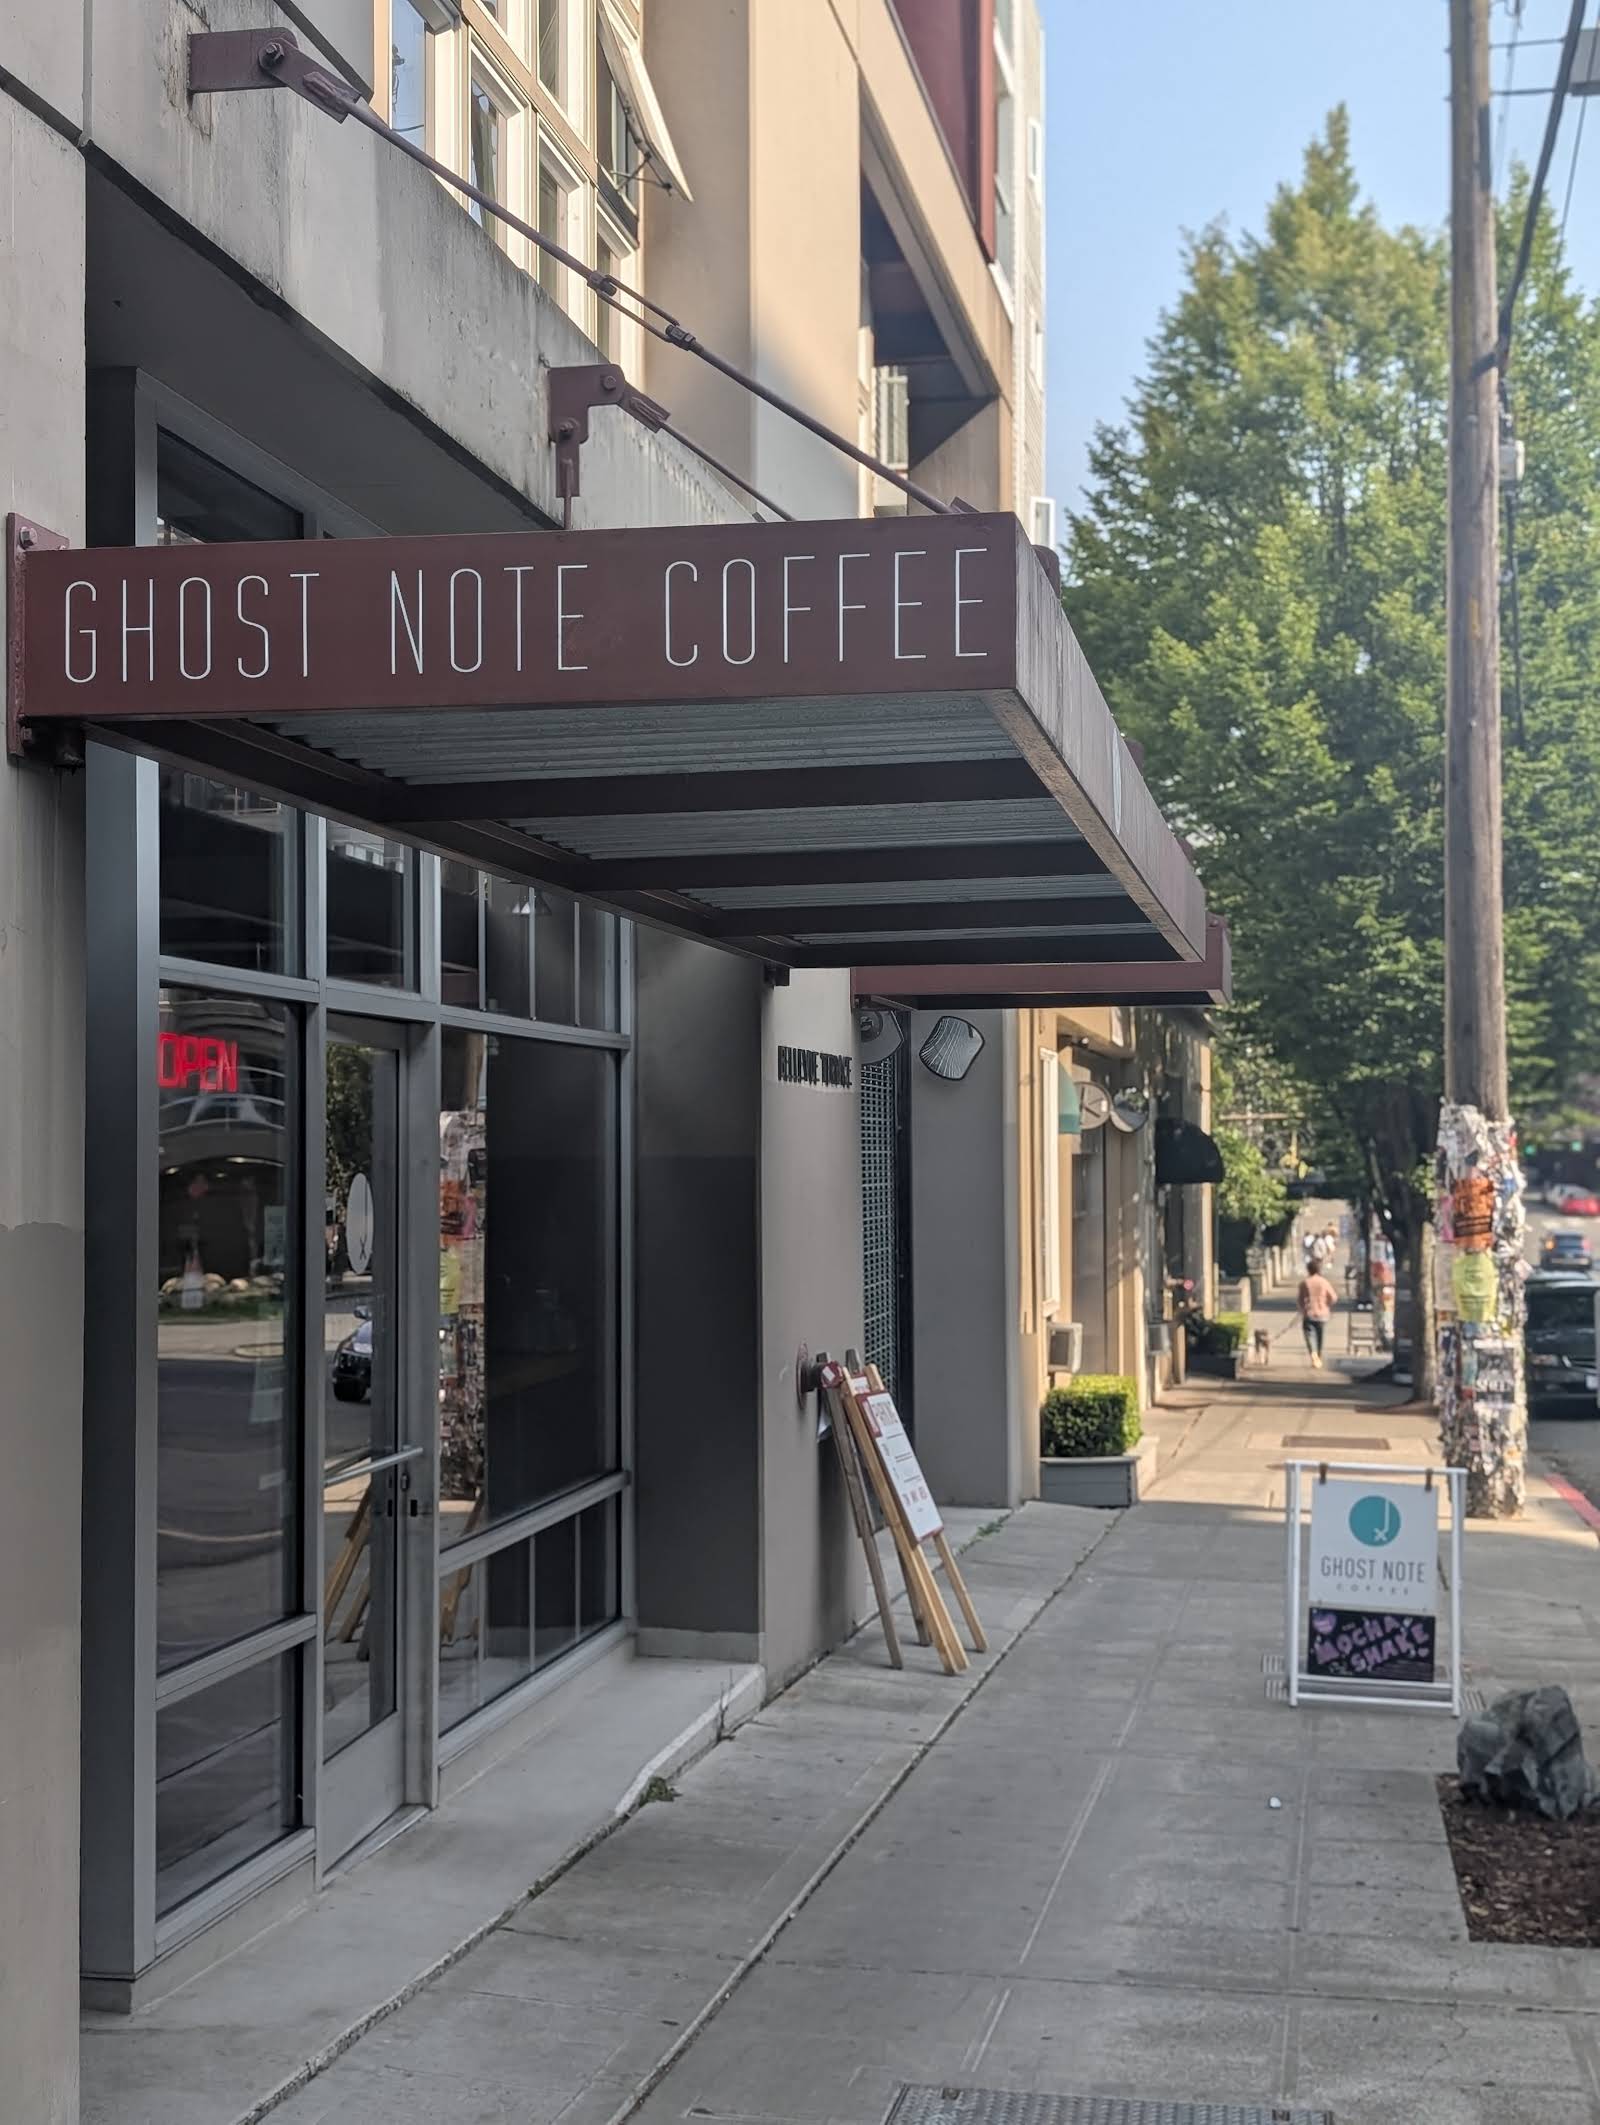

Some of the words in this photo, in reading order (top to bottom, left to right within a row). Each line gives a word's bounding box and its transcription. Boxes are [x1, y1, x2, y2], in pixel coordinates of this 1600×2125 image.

[64, 572, 320, 684] GHOST
[390, 564, 588, 674] NOTE
[664, 548, 988, 667] COFFEE
[158, 1032, 238, 1094] OPEN
[1320, 1555, 1376, 1579] GHOST
[1382, 1560, 1426, 1583] NOTE
[1314, 1615, 1401, 1665] MOCHA
[1350, 1622, 1430, 1673] SHAKE
